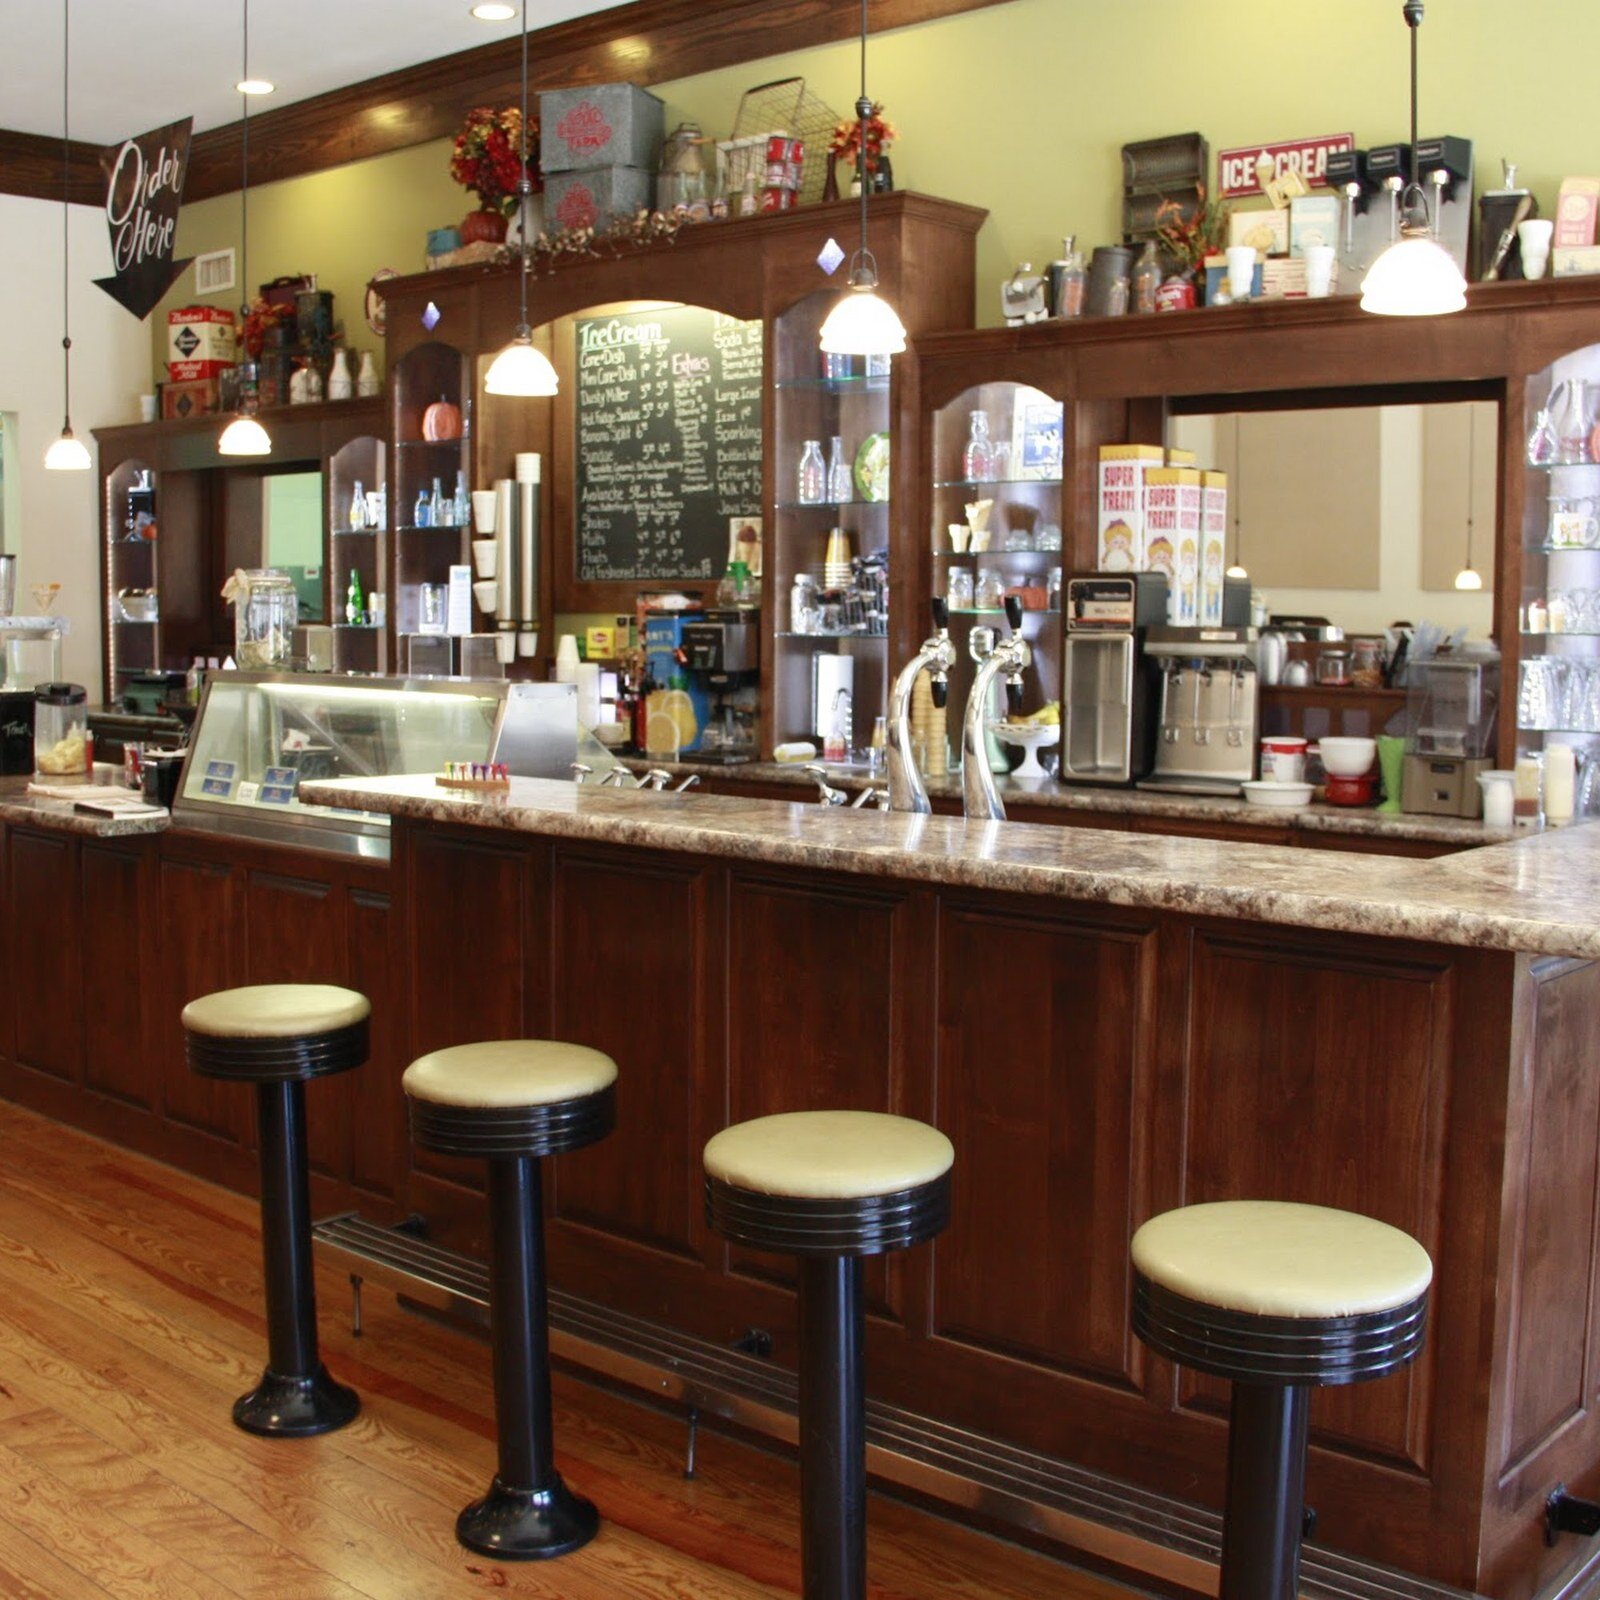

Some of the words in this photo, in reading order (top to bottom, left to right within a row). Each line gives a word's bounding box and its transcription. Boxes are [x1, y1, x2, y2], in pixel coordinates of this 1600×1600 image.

[107, 140, 181, 224] Order
[1222, 157, 1256, 190] ICE
[115, 206, 174, 272] Here
[672, 352, 710, 377] Extras
[581, 389, 605, 408] Dusty
[605, 386, 631, 402] Miller
[581, 411, 595, 426] Hot
[595, 409, 615, 428] Fudge
[581, 428, 609, 444] Banana
[608, 422, 631, 444] Split
[1104, 466, 1134, 487] SUPER
[1148, 489, 1176, 507] SUPER
[581, 513, 611, 530] Shakes
[581, 564, 597, 580] Old
[651, 563, 679, 578] Cream
